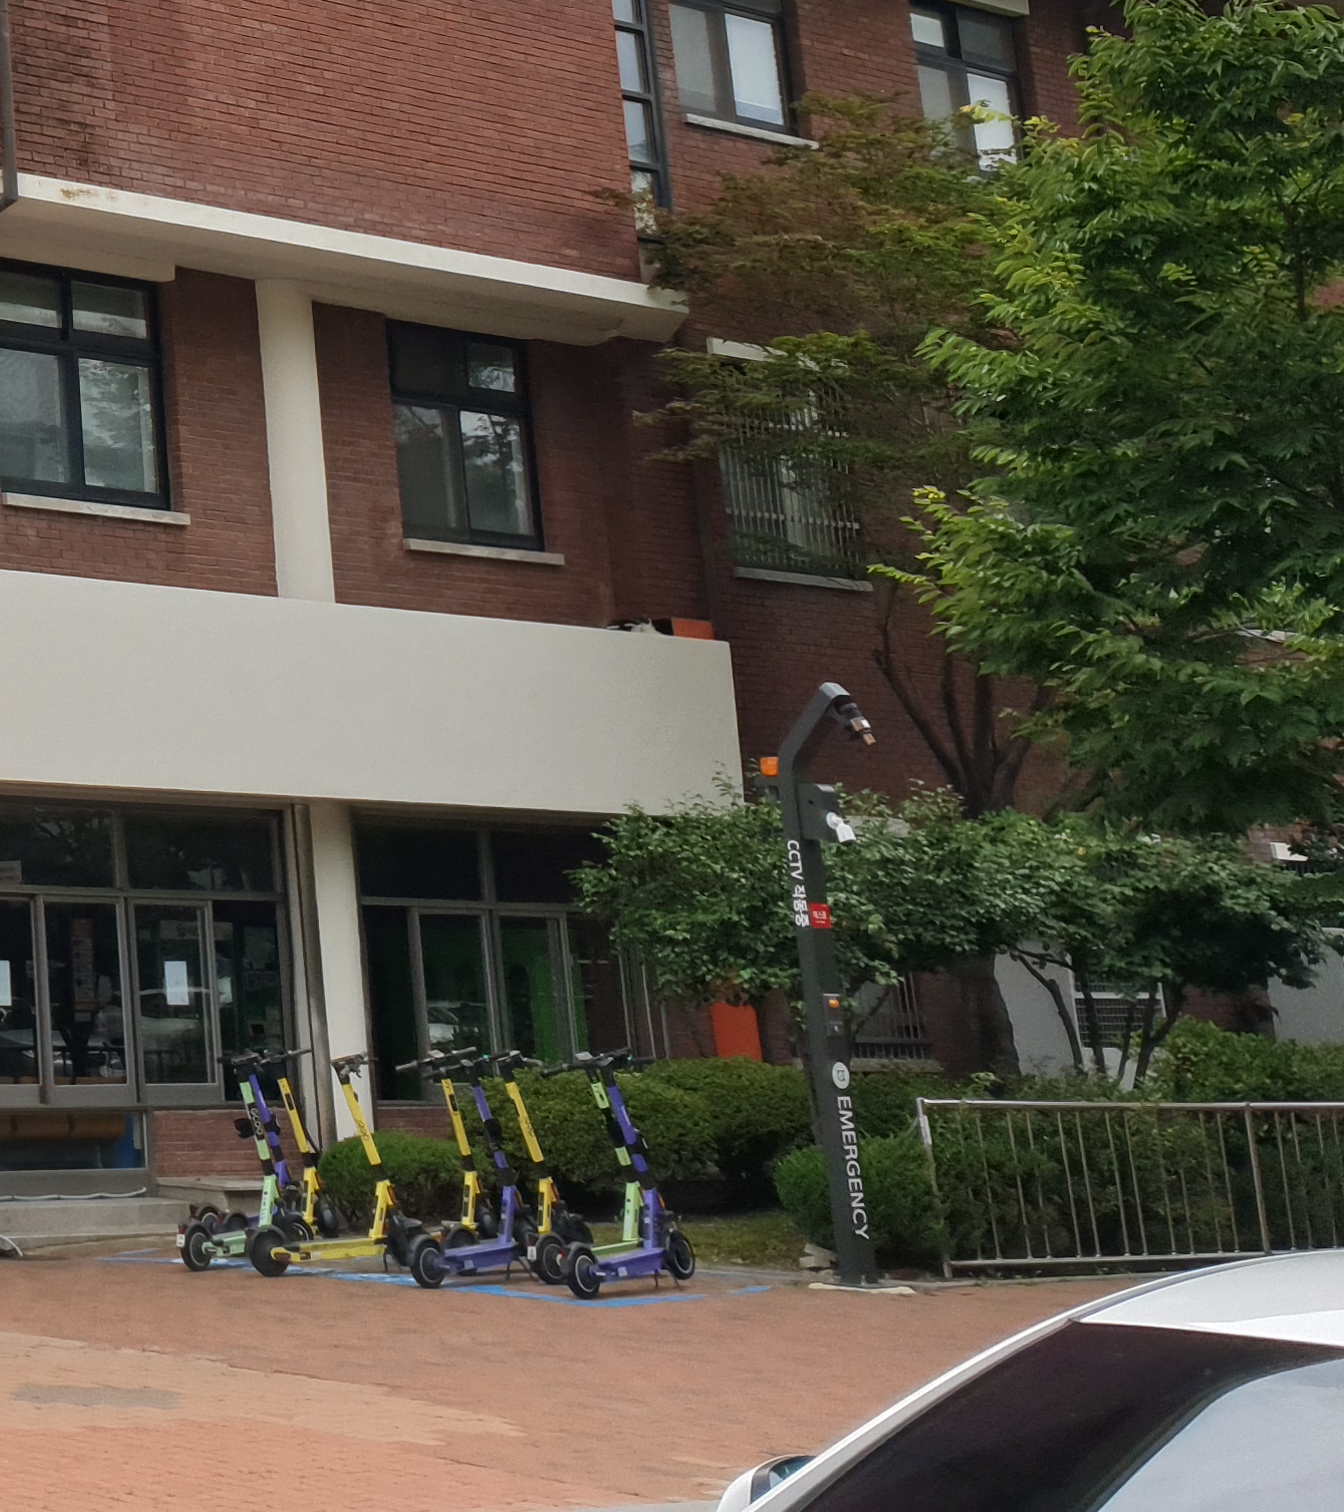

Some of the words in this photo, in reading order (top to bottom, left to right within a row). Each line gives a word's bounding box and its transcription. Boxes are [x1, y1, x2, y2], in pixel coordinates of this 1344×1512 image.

[787, 840, 804, 880] CCTV
[792, 884, 809, 927] 작동중
[837, 1095, 870, 1240] EMERGENCY
